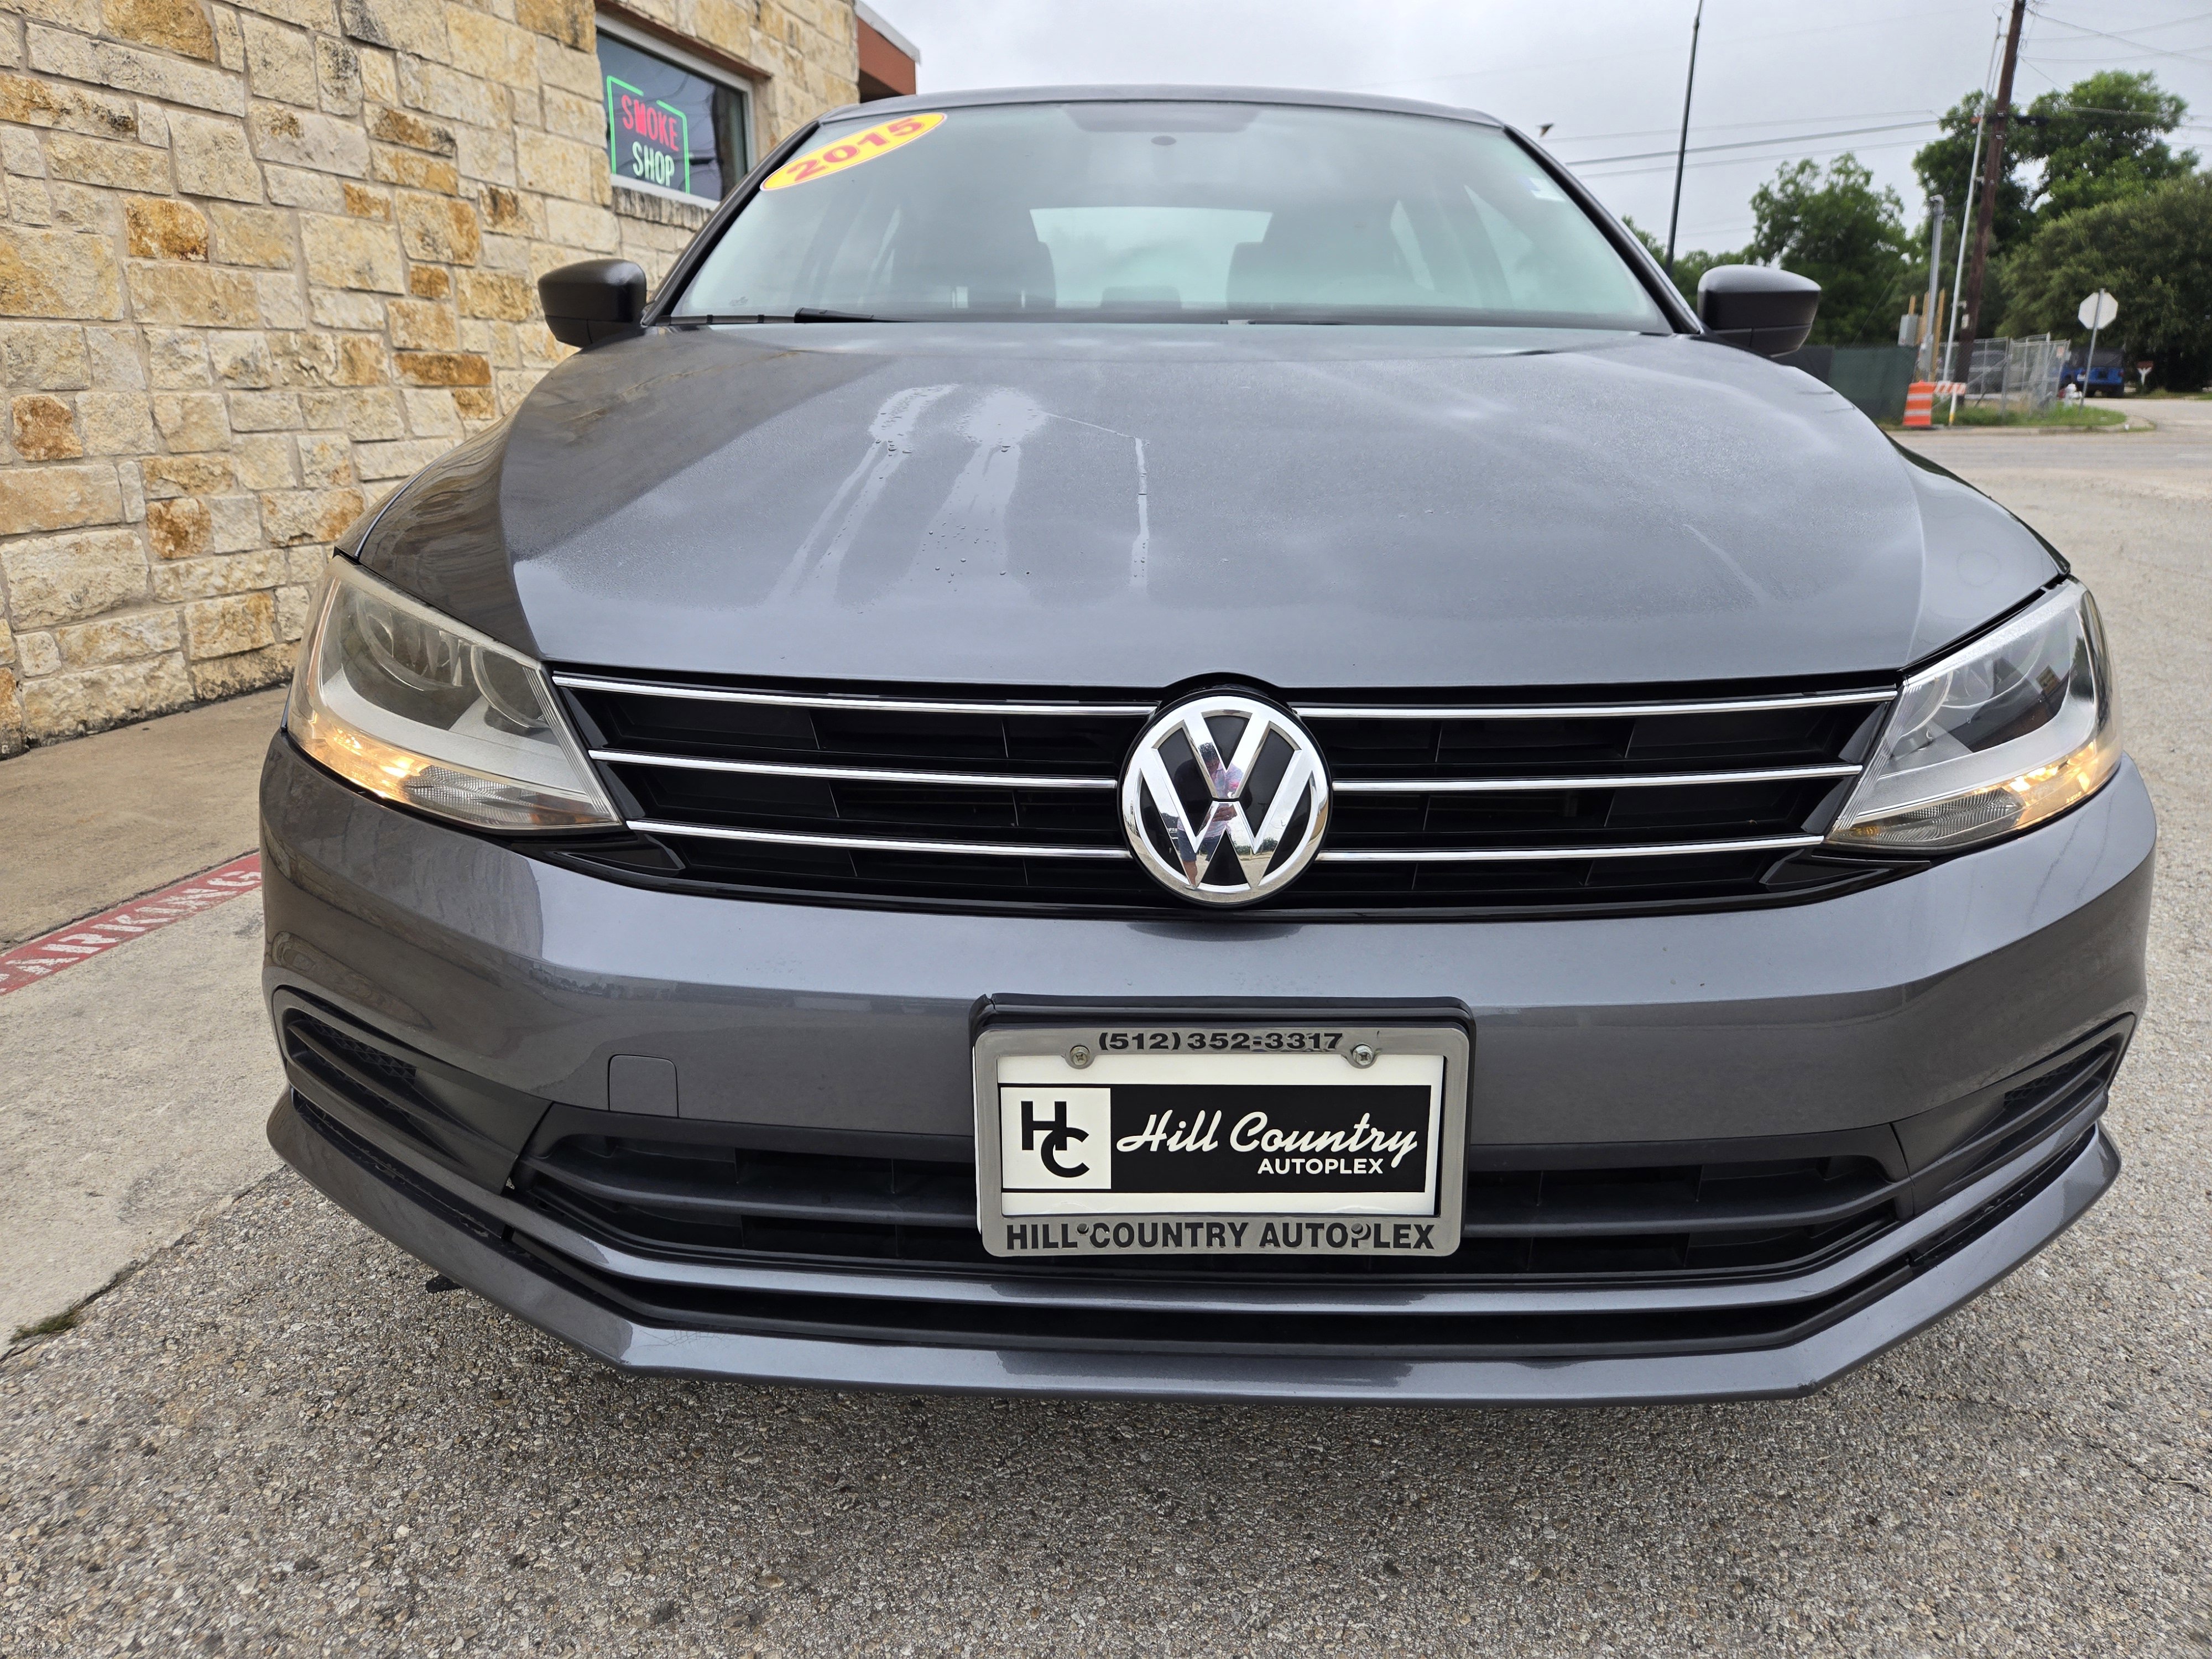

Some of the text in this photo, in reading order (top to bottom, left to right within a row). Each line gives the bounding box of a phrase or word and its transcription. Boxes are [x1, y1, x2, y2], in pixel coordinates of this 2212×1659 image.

[621, 95, 680, 152] SMOKE
[632, 141, 675, 187] SHOP
[786, 117, 925, 182] 2015
[1116, 1109, 1418, 1168] Hill Country
[1257, 1157, 1384, 1175] AUTOPLEX
[1006, 1222, 1435, 1250] HILL COUNTRY AUTOPLEX
